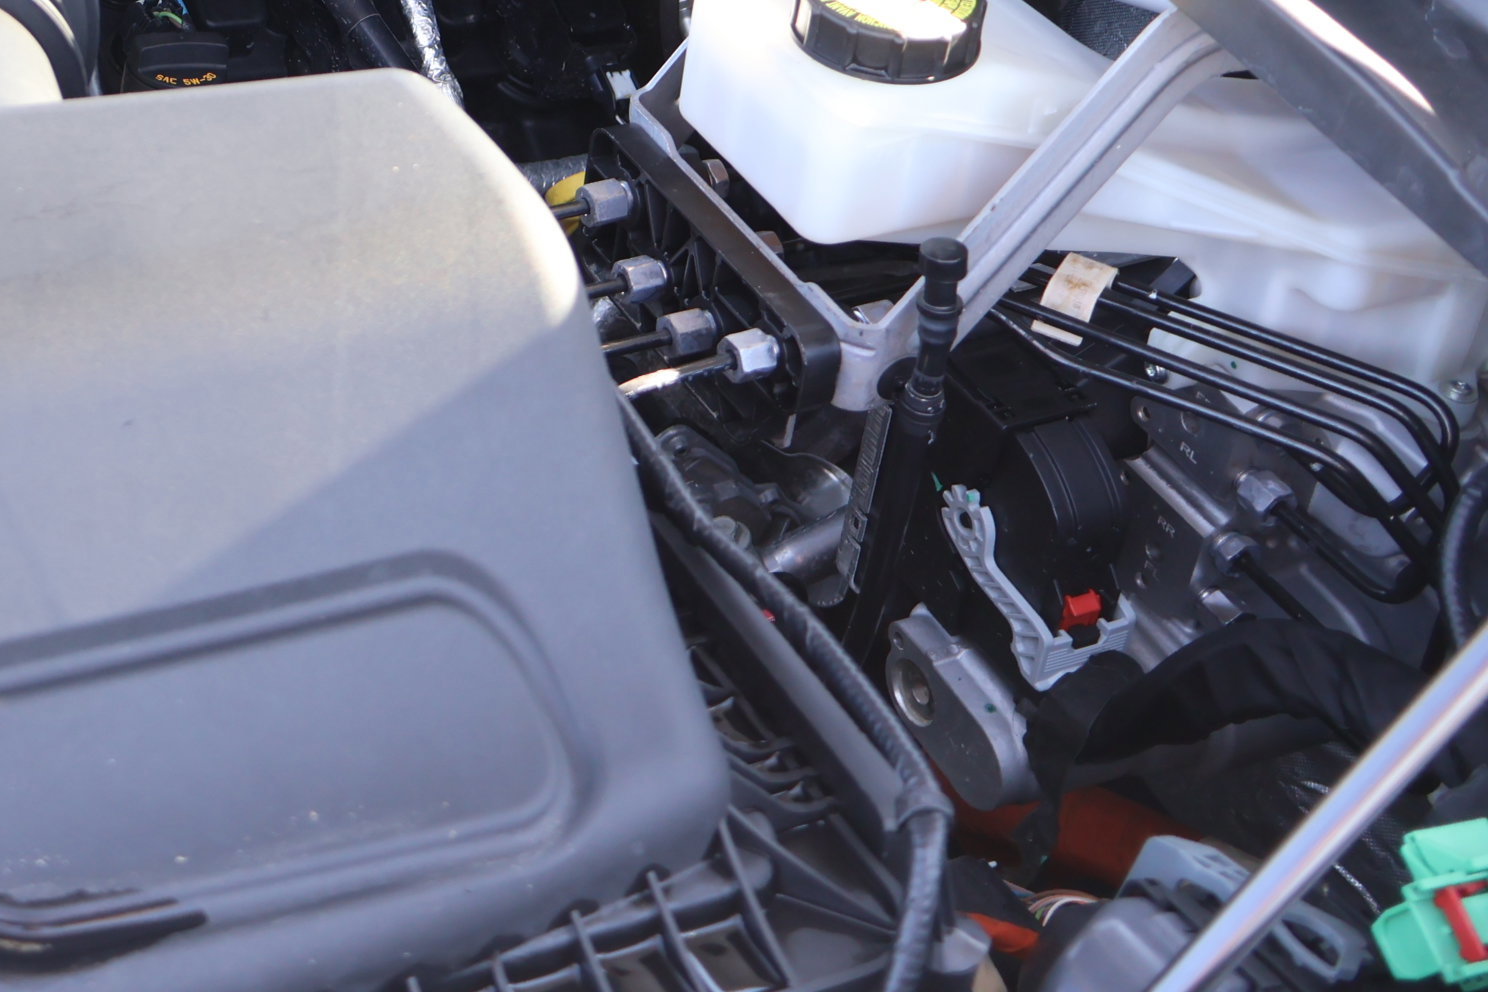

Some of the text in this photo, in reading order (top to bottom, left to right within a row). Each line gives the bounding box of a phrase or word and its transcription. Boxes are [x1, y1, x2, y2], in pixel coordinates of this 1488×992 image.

[182, 72, 217, 86] 5W-30
[1179, 441, 1197, 465] RL
[1157, 515, 1176, 539] RR
